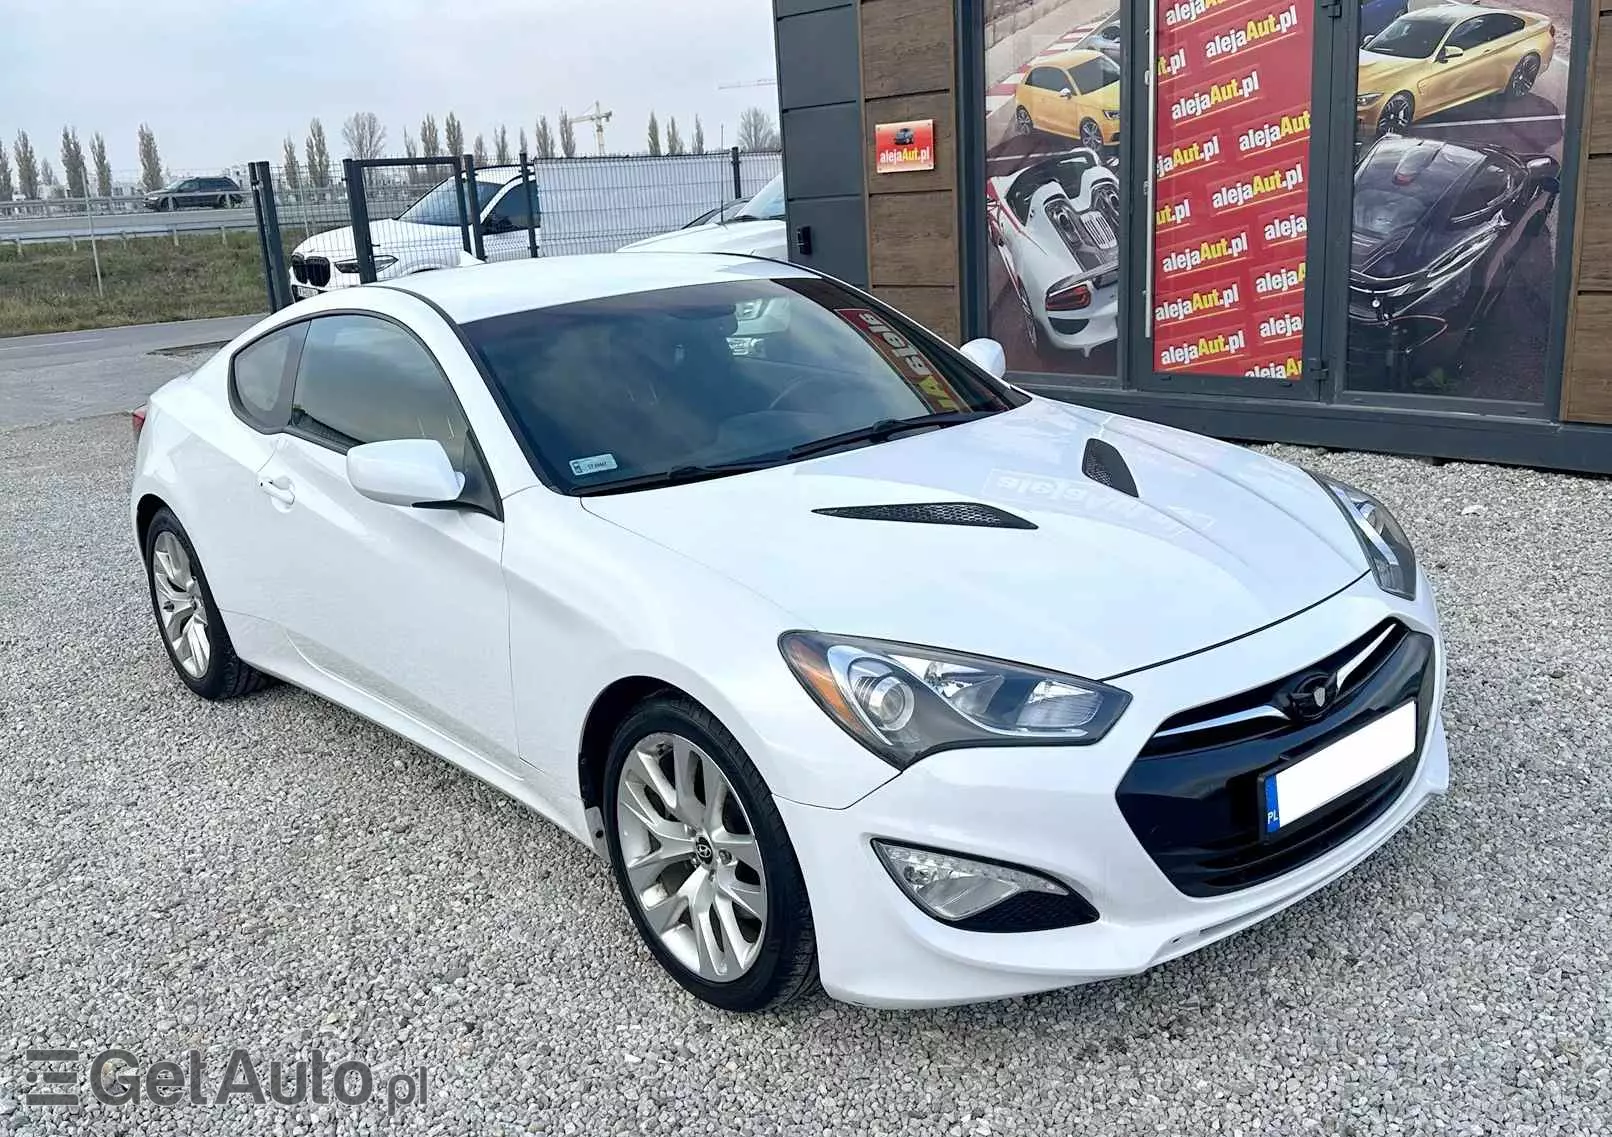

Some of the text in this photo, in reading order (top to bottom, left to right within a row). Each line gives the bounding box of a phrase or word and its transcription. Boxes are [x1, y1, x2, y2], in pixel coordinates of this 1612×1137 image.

[1205, 5, 1297, 58] alejaAut.pl
[1171, 71, 1260, 120] alejaAut.pl
[880, 146, 930, 165] alejaAut.pl
[1157, 135, 1220, 178] jaAut.pl
[1212, 163, 1303, 209] alejaAut.pl
[1163, 232, 1248, 273] alejaAut.pl
[1155, 283, 1239, 321] alejaAut.pl
[1161, 330, 1245, 365] alejaAut.pl
[1267, 811, 1279, 824] PL
